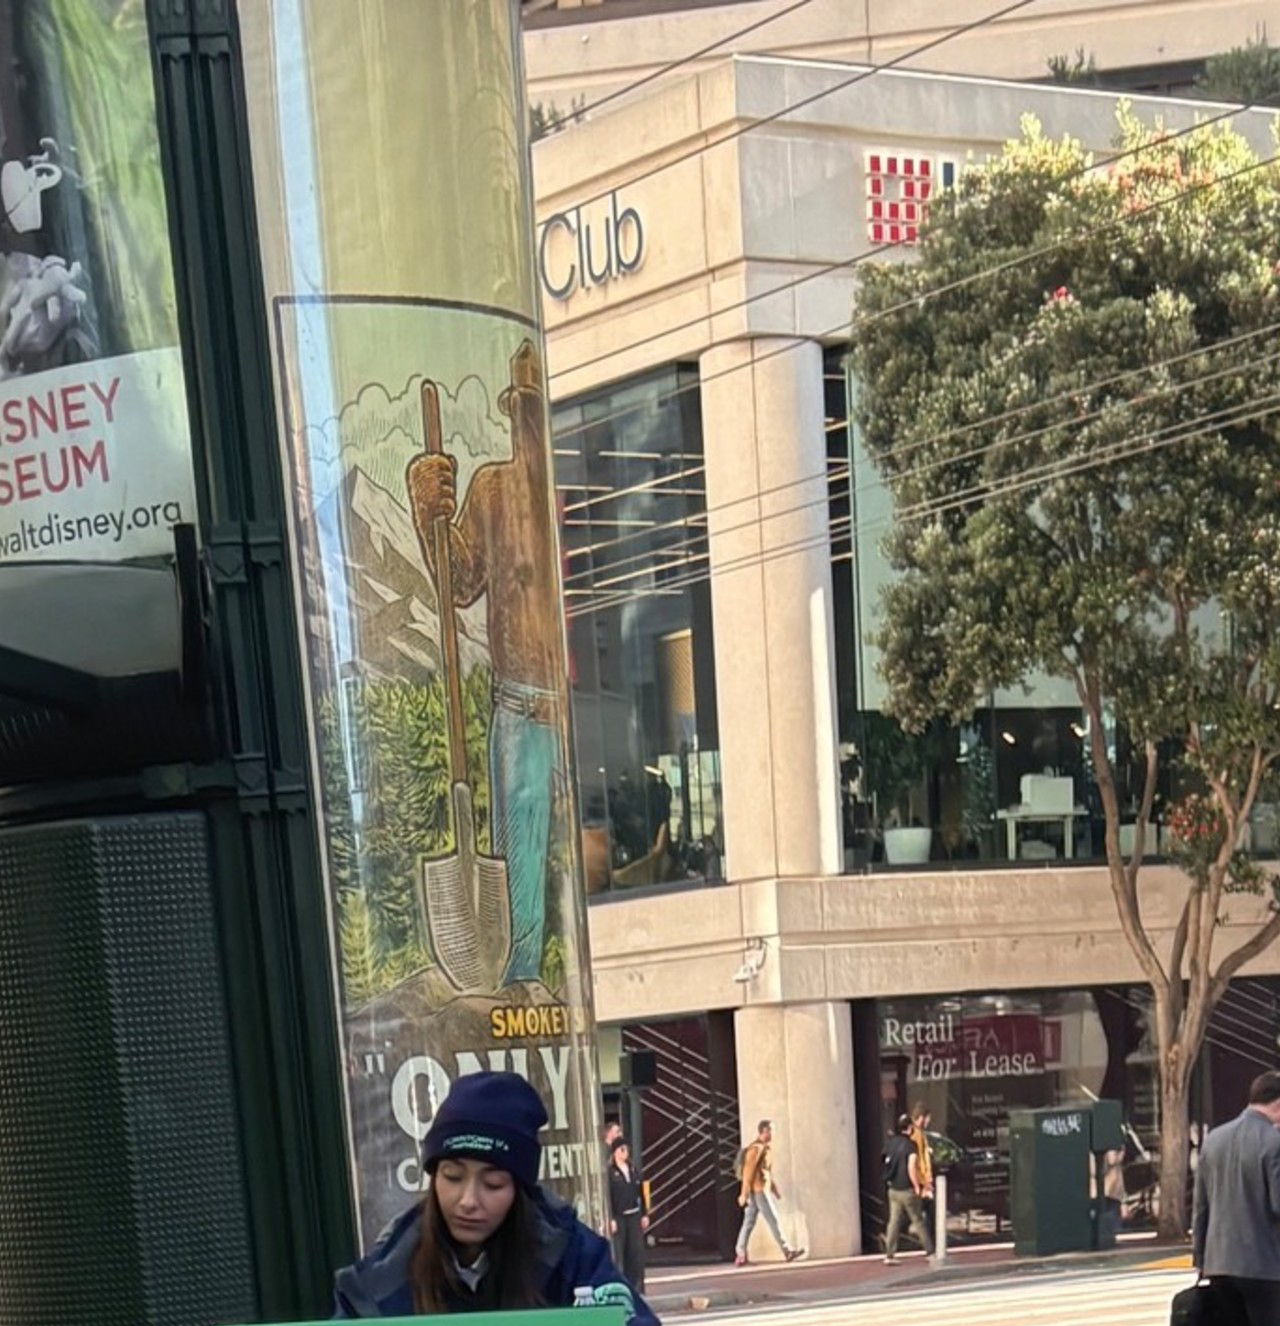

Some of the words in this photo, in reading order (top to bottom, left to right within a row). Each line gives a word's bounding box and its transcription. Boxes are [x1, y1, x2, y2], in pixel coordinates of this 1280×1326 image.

[540, 191, 643, 300] Club
[884, 1014, 955, 1046] Retail
[917, 1053, 956, 1081] For
[969, 1050, 1036, 1077] Lease
